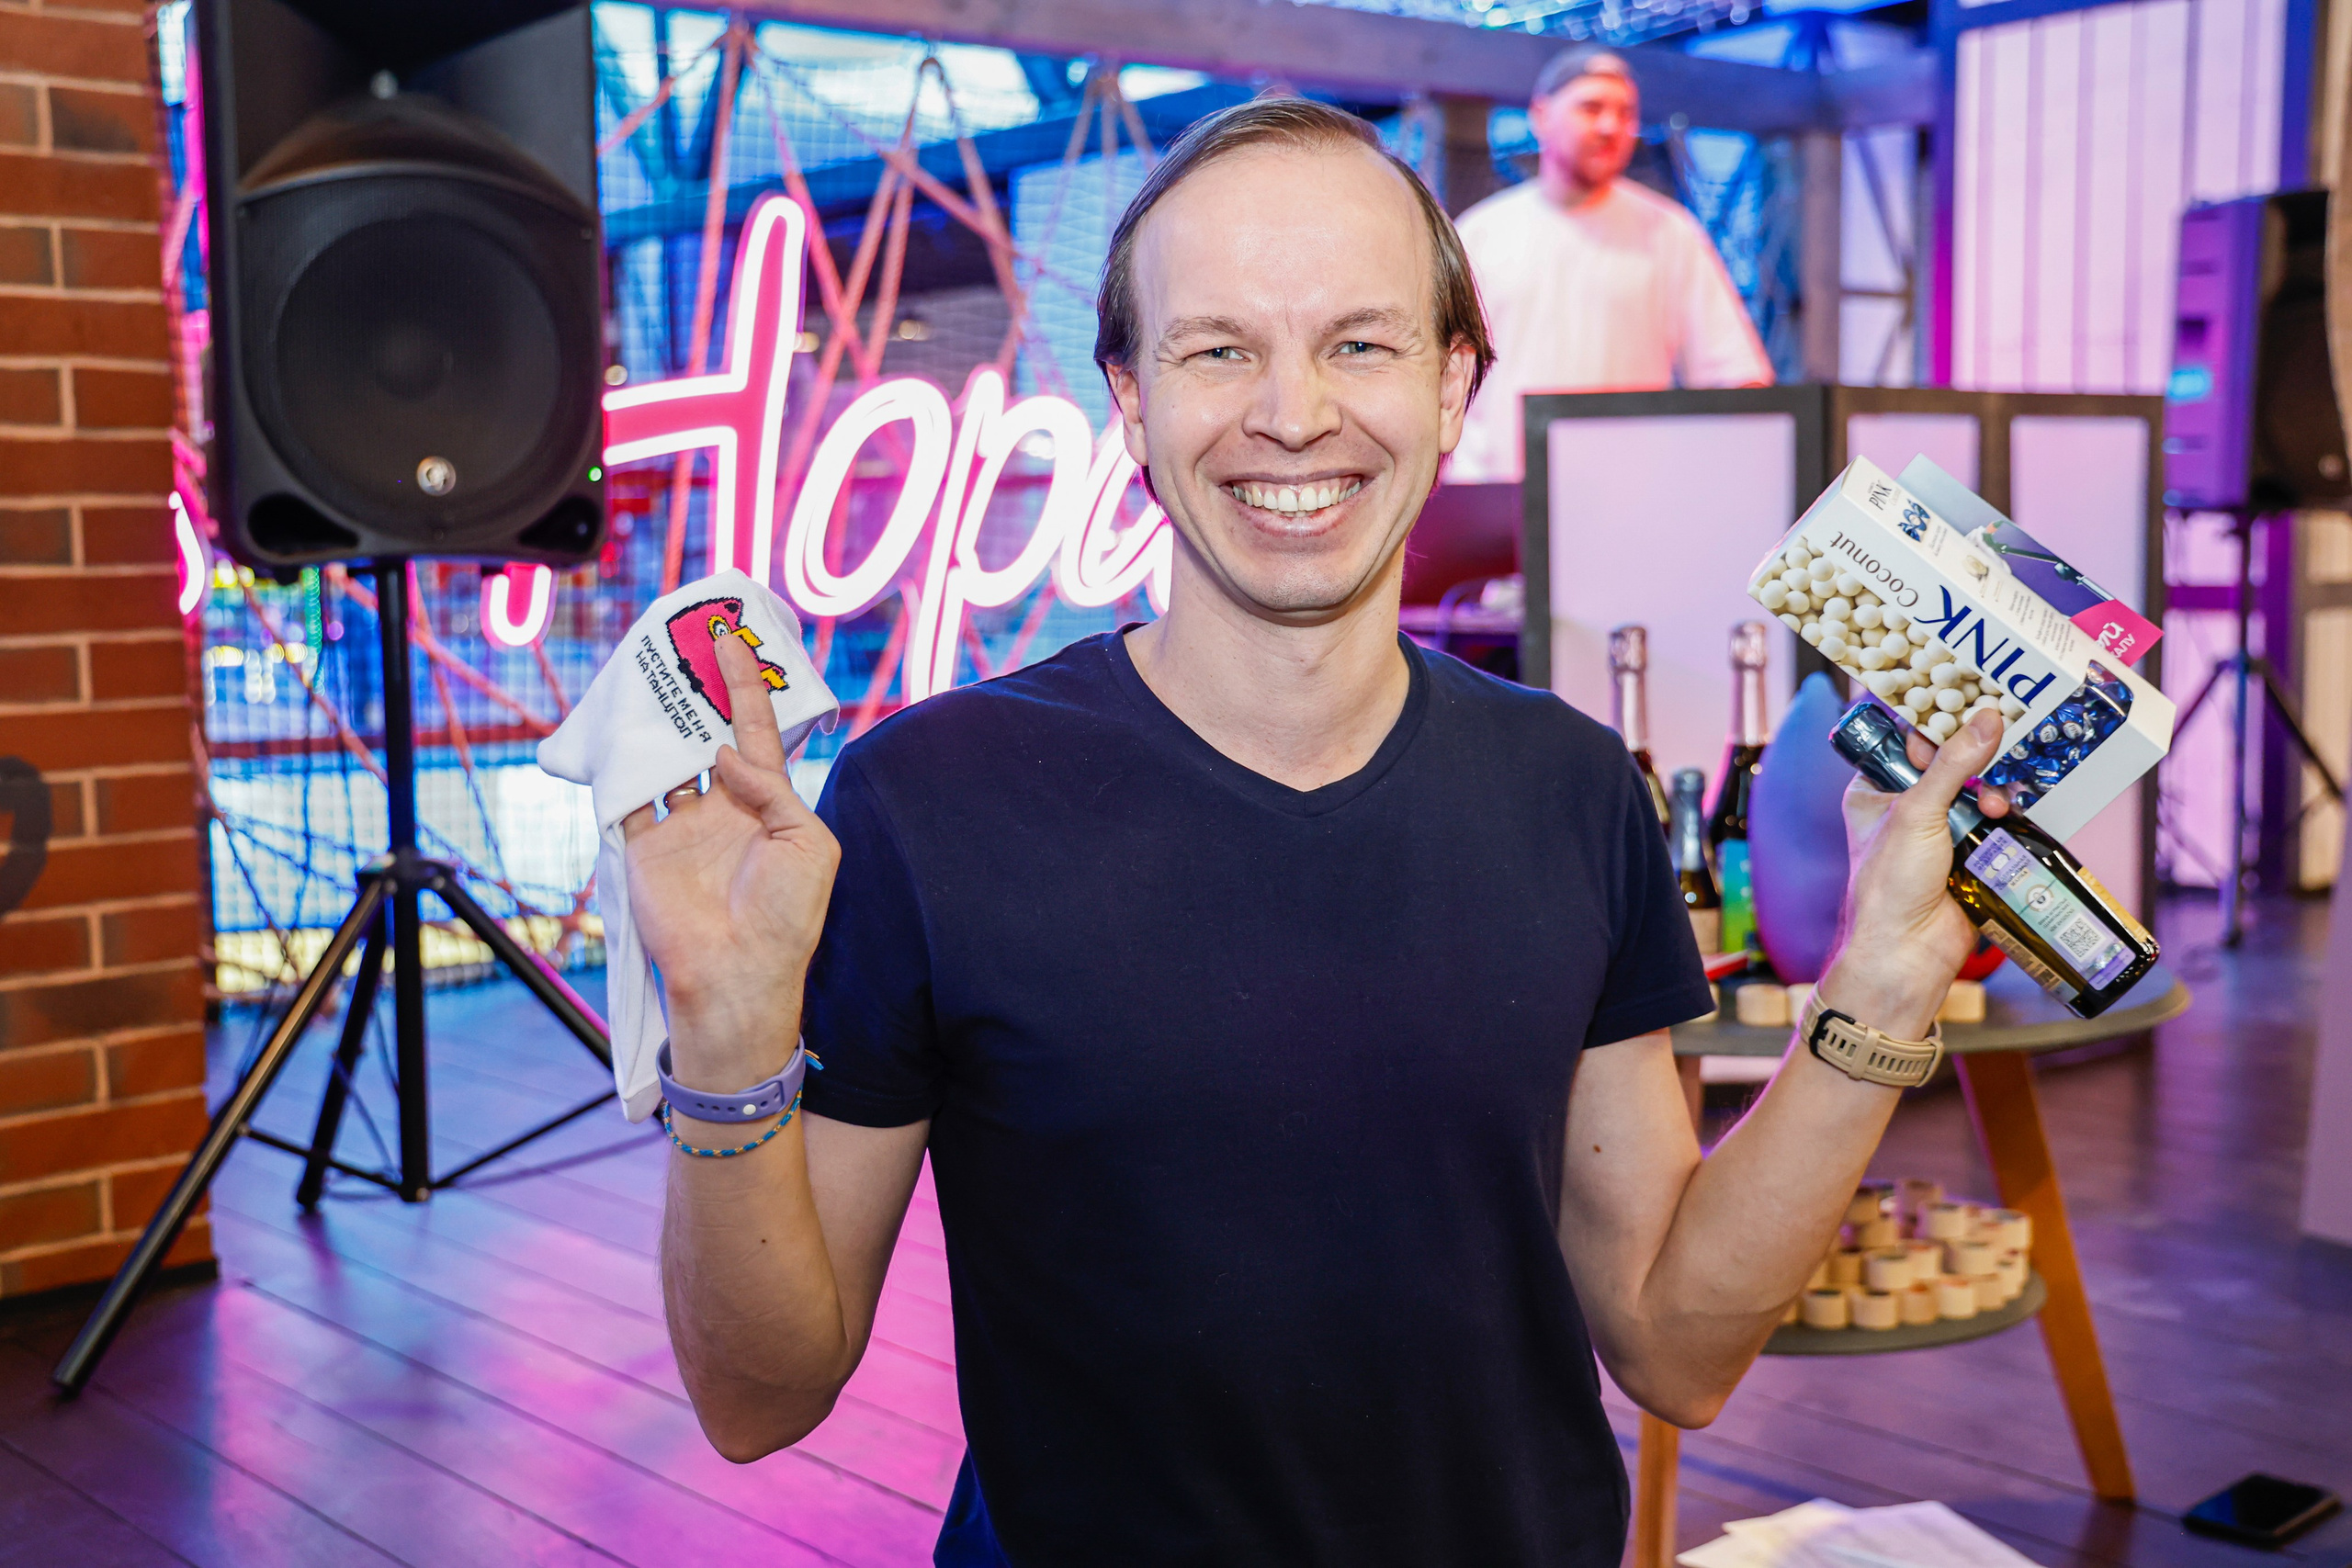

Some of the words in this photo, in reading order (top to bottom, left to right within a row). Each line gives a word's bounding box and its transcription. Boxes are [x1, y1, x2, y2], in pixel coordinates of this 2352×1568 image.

[1829, 531, 1918, 608] Coconut
[641, 635, 683, 698] ПУСТИТЕ
[677, 697, 712, 742] МЕНЯ
[1913, 584, 2057, 709] PINK
